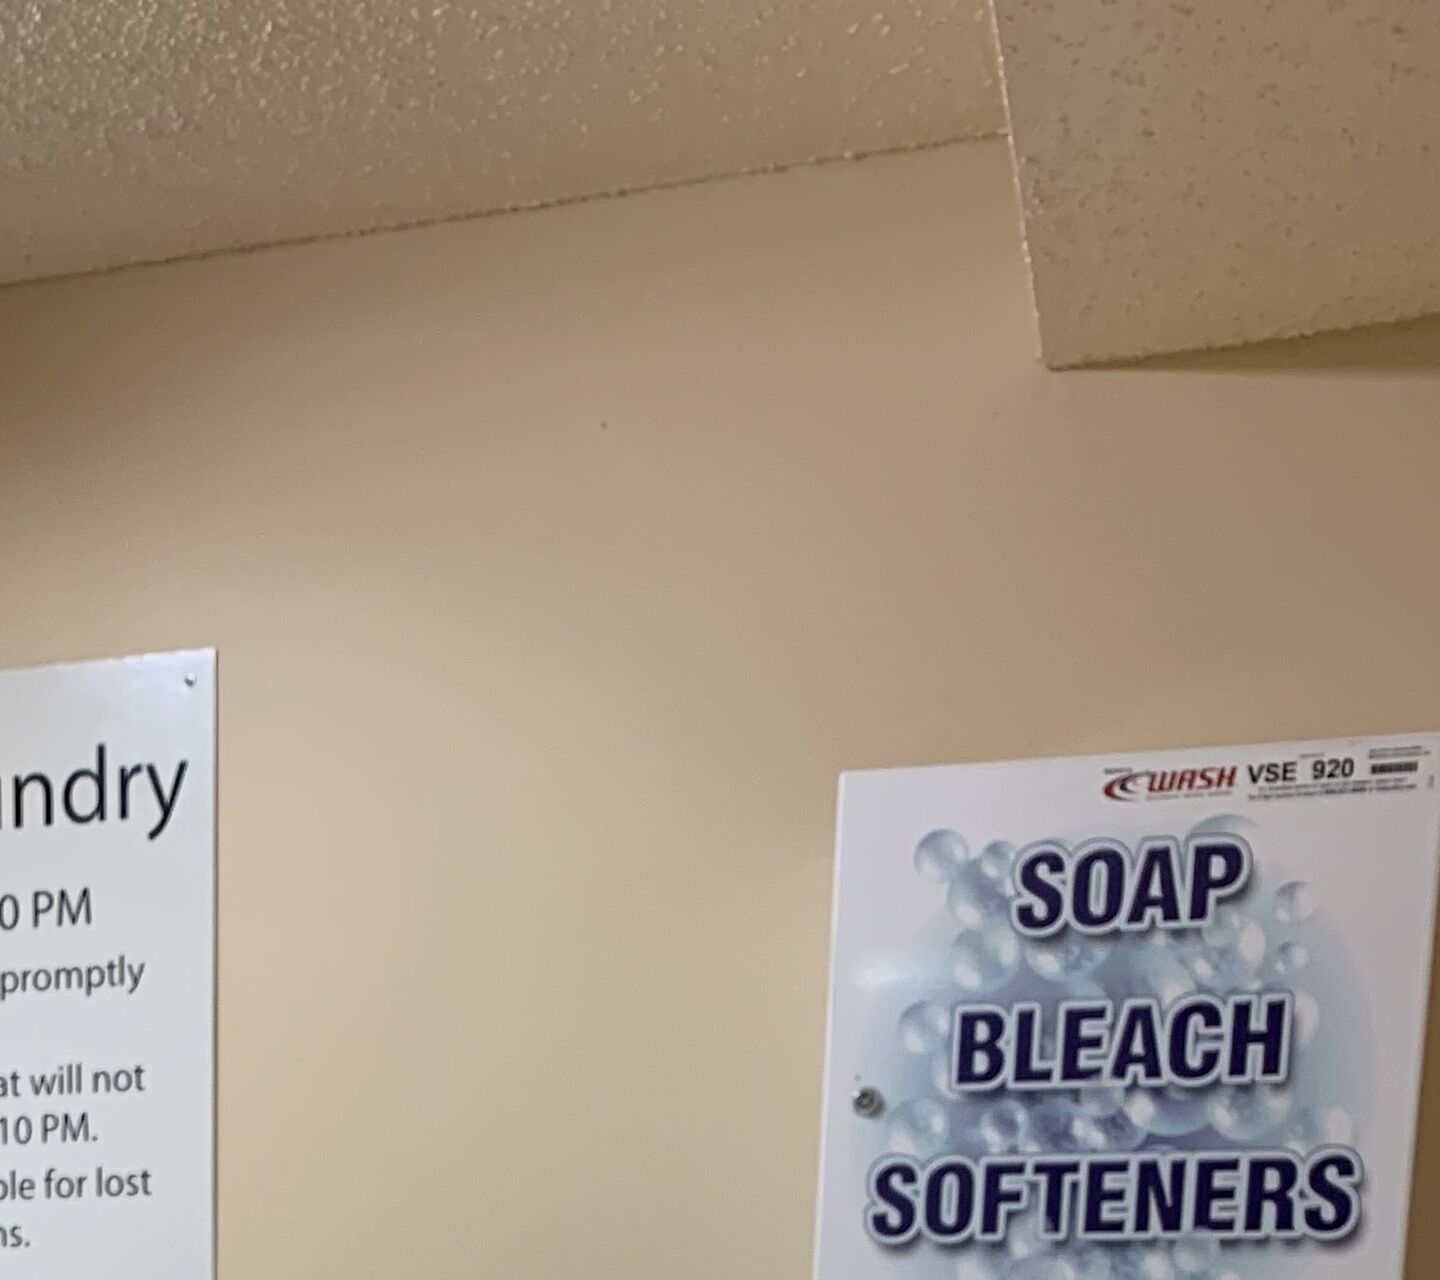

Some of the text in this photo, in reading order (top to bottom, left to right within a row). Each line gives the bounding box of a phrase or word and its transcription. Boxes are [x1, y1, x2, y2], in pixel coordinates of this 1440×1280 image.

[1146, 765, 1239, 793] WASH
[1247, 761, 1299, 784] VSE
[1311, 758, 1355, 780] 920
[1013, 839, 1248, 931] SOAP
[30, 885, 94, 931] PM
[954, 997, 1290, 1087] BLEACH
[27, 1061, 84, 1098] will
[90, 1063, 147, 1095] not
[39, 1110, 100, 1146] PM.
[42, 1166, 89, 1201] for
[94, 1164, 154, 1199] lost
[869, 1152, 1358, 1239] SOFTENERS
